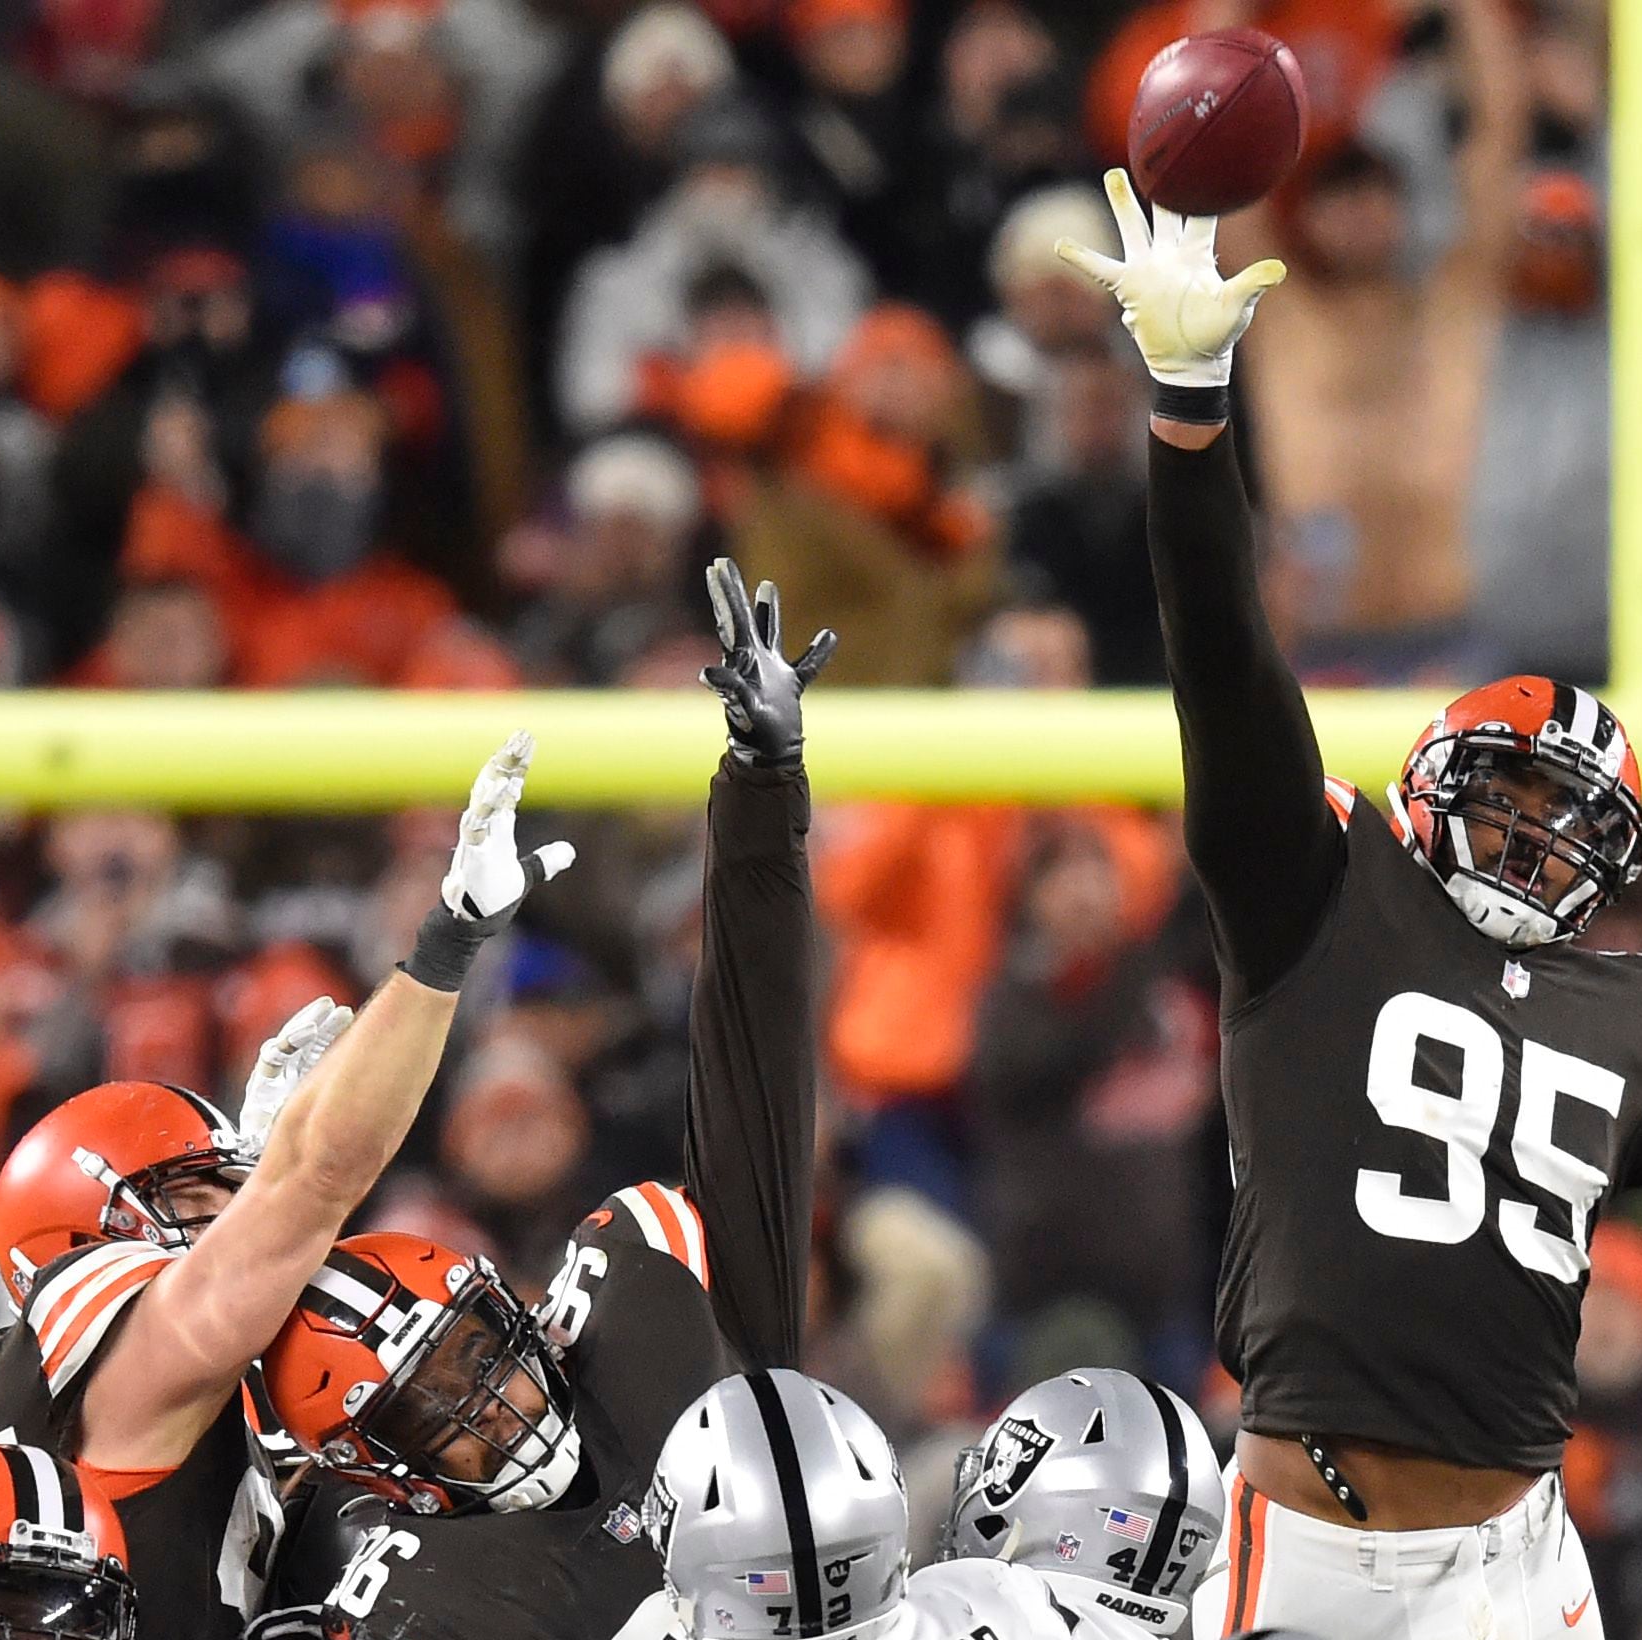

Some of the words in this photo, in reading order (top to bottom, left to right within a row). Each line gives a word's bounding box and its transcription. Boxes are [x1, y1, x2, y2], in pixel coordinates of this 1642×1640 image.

[1355, 991, 1627, 1285] 95
[390, 1310, 423, 1347] BROWNS
[1004, 1418, 1048, 1448] RAIDERS
[1095, 1592, 1169, 1625] RAIDERS
